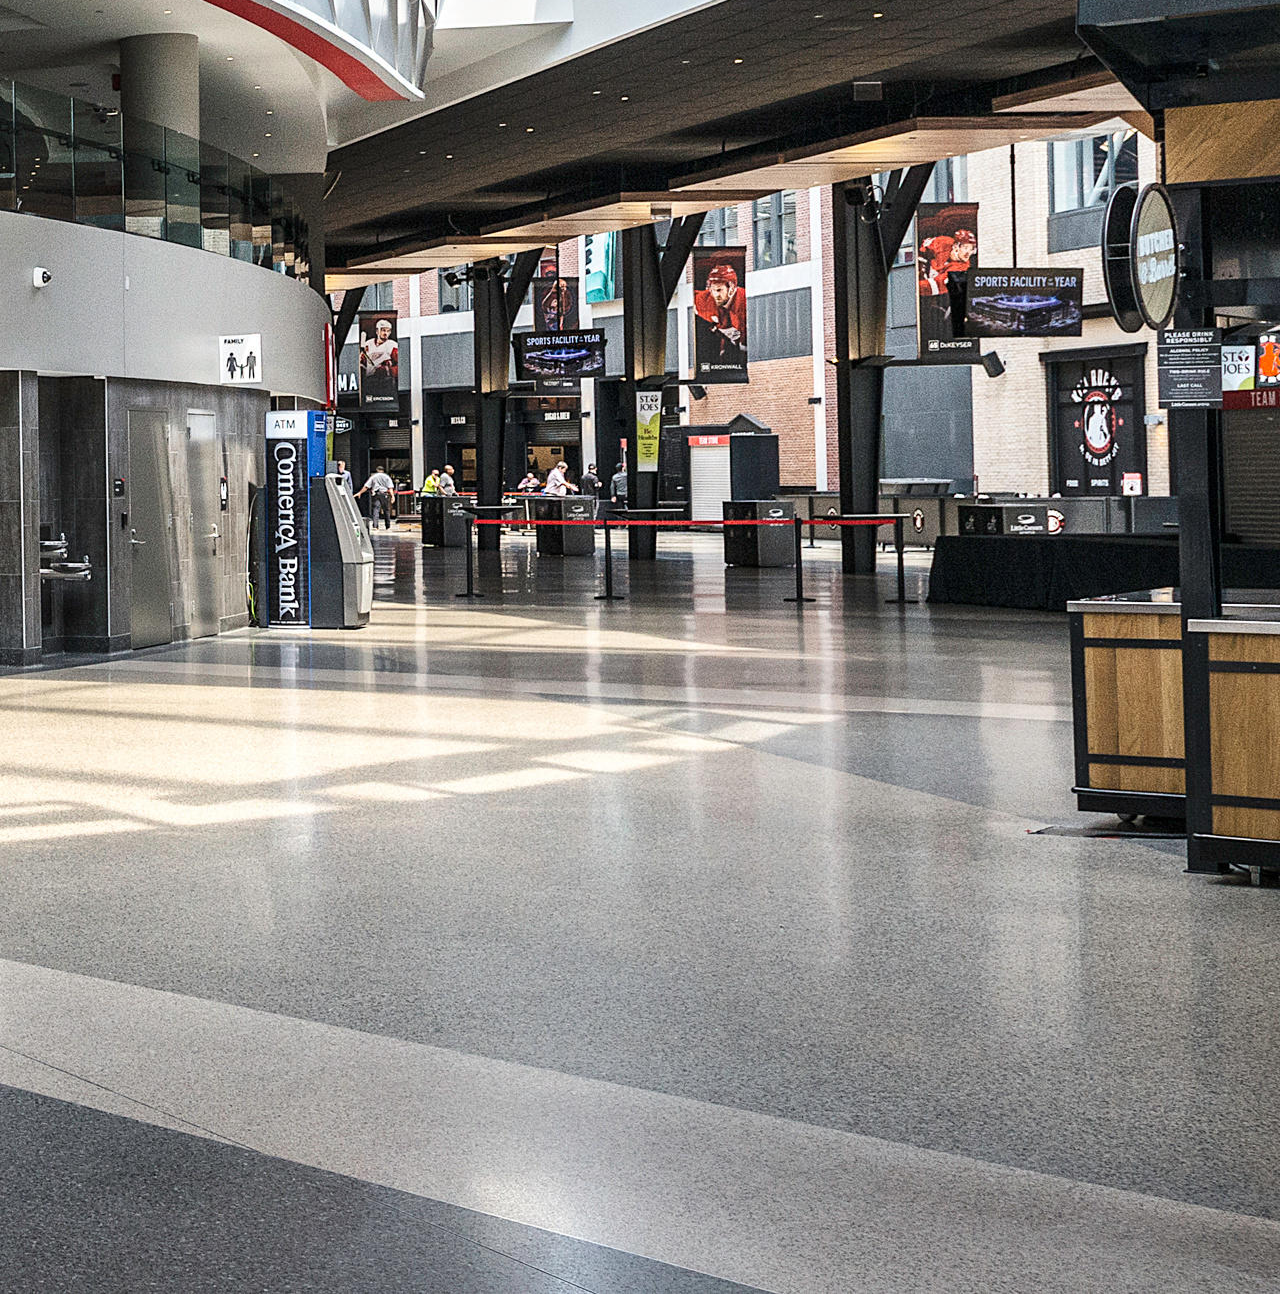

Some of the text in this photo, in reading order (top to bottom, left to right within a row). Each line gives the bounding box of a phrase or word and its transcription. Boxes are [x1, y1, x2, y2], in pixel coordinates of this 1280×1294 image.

[974, 276, 1009, 288] SPORTS
[1010, 276, 1047, 288] FACILITY
[1054, 276, 1077, 288] YEAR
[526, 336, 551, 346] SPORTS
[552, 335, 578, 345] FACILITY
[584, 334, 600, 343] YEAR
[1223, 364, 1250, 374] JOES
[1250, 391, 1276, 406] TEAM
[274, 419, 296, 429] ATM
[278, 556, 300, 621] Bank
